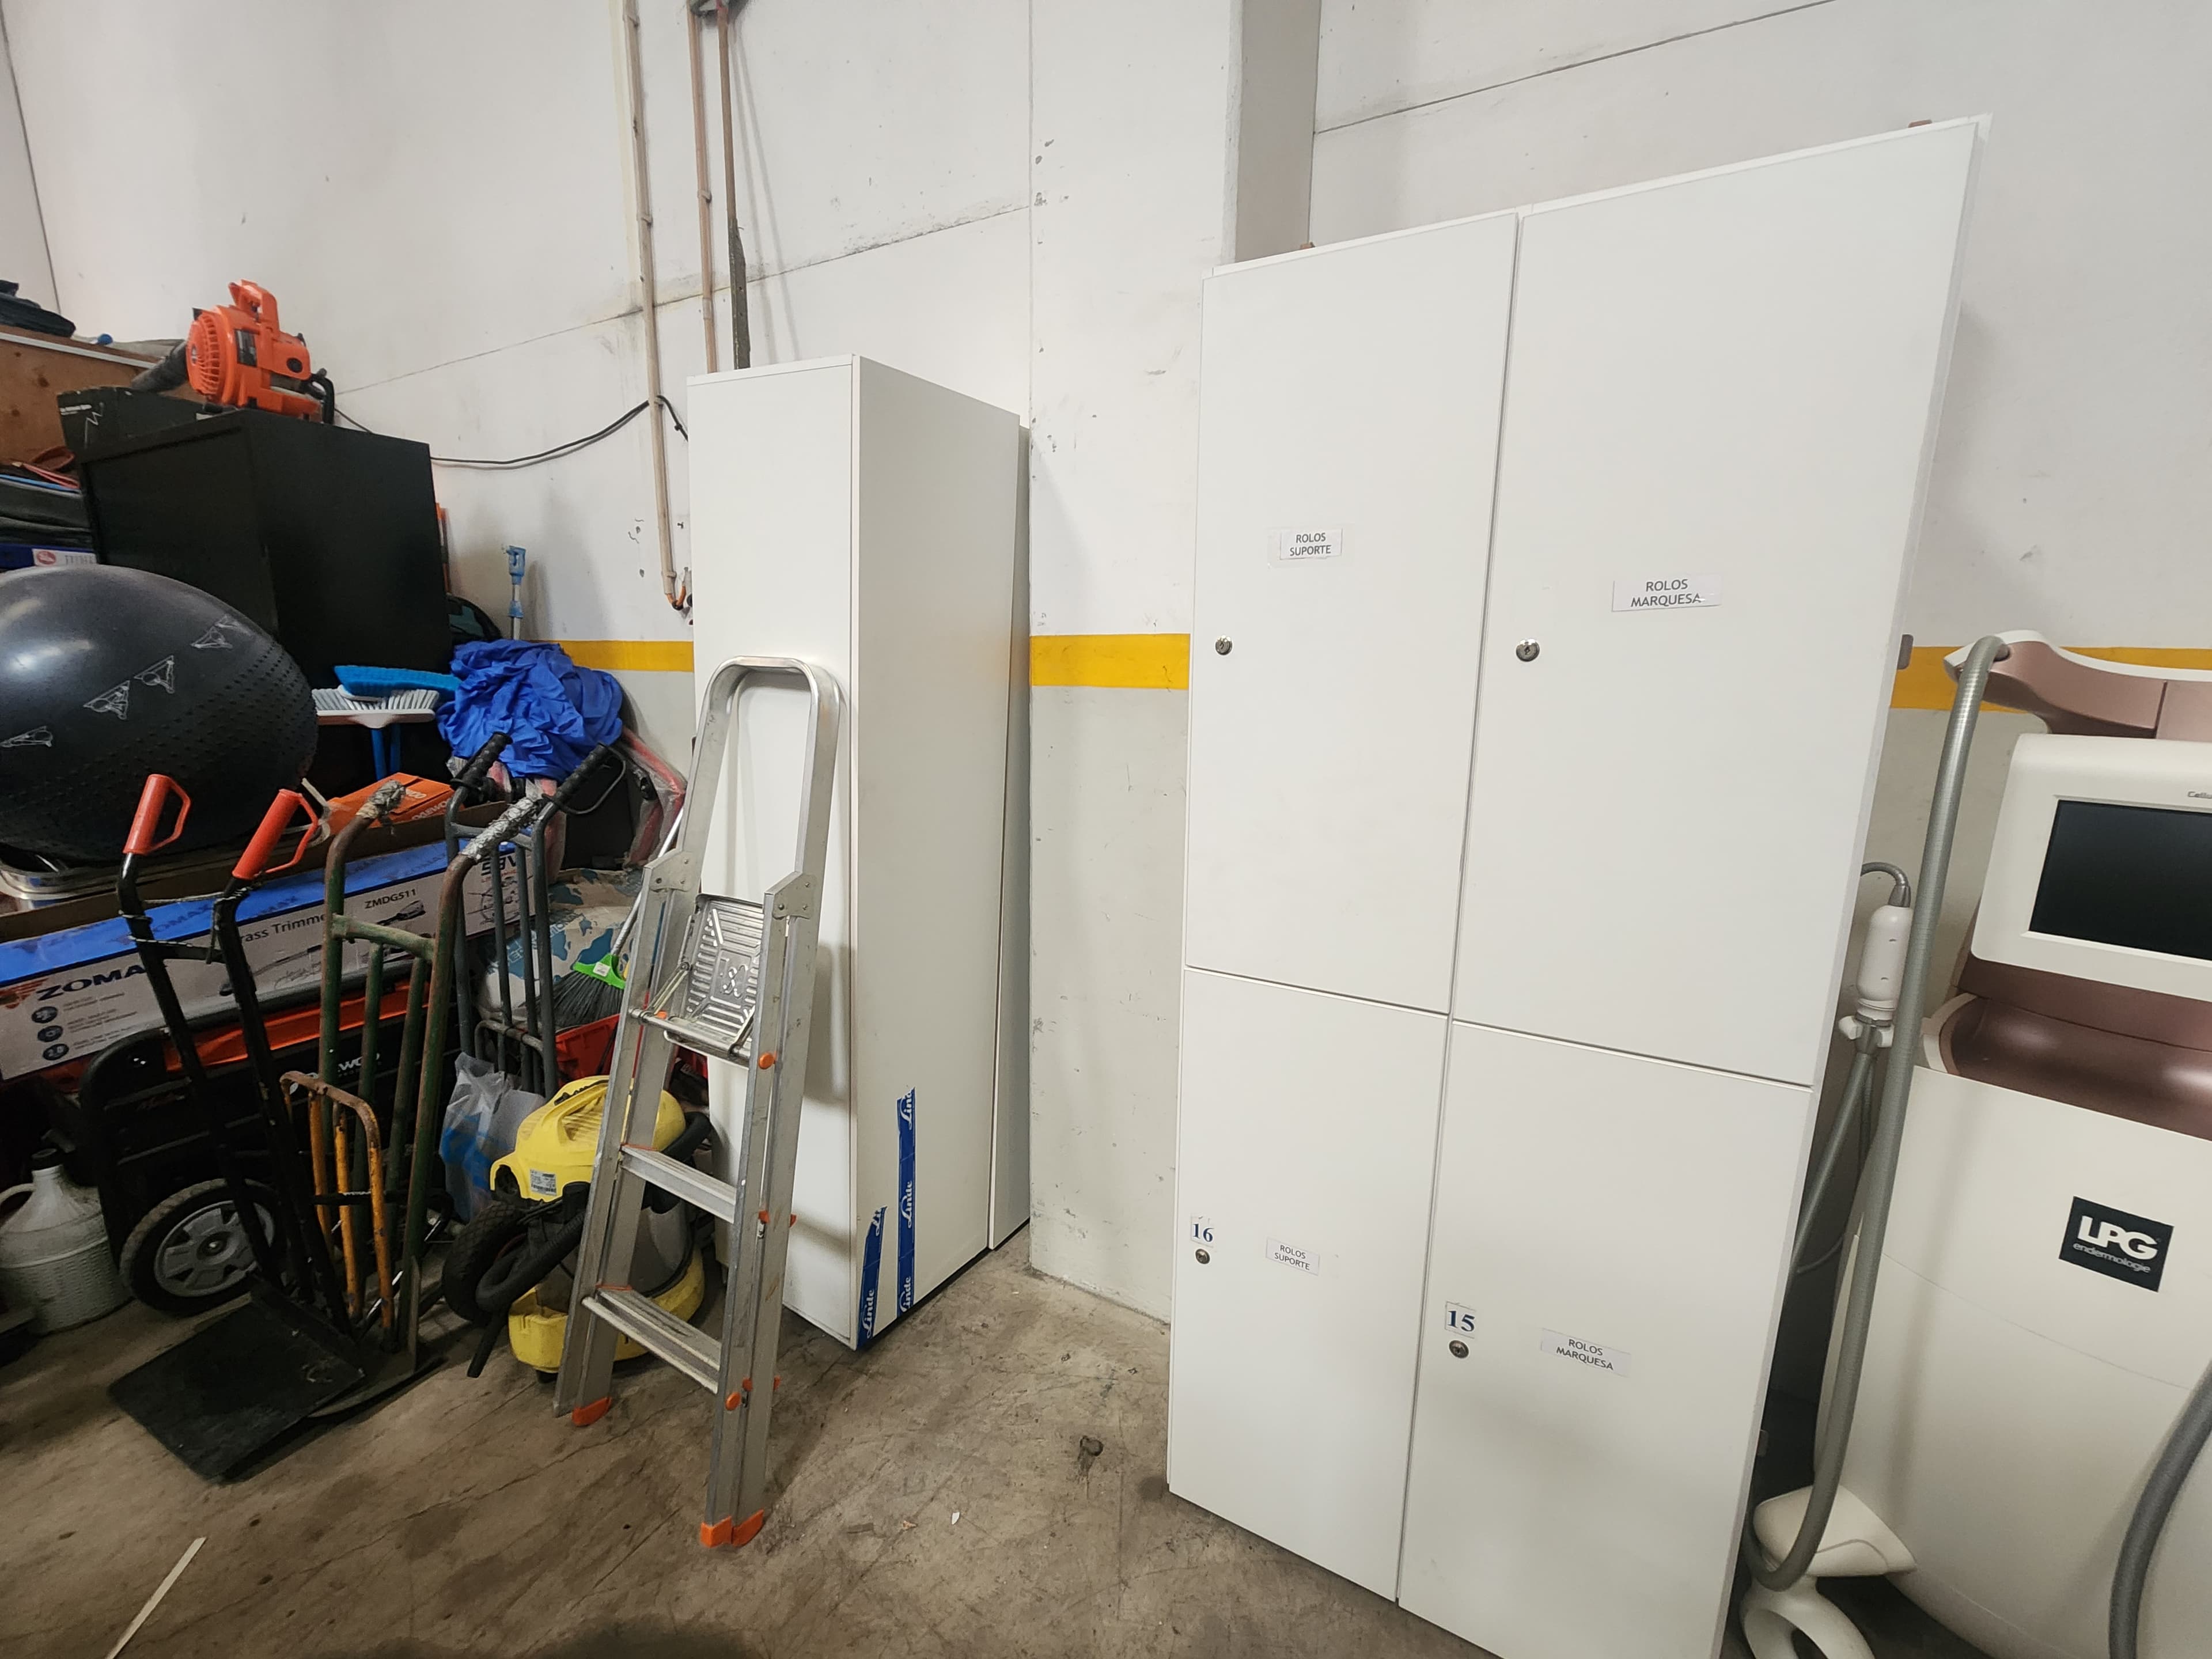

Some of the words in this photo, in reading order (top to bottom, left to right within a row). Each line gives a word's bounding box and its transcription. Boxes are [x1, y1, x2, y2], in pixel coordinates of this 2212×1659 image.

[1296, 532, 1327, 543] ROLOS
[1290, 544, 1332, 556] SUPORTE
[1646, 578, 1688, 592] ROLOS
[1630, 593, 1702, 607] MARQUESA
[411, 798, 450, 820] DAEWO
[239, 929, 269, 943] rass
[272, 912, 327, 934] Trimme
[35, 964, 145, 1001] ZOMA
[901, 1181, 913, 1229] Linde
[1192, 1223, 1215, 1243] 16
[2077, 1215, 2158, 1260] LPG
[1274, 1252, 1310, 1271] SUPORTE
[1279, 1244, 1306, 1259] ROLOS
[862, 1290, 876, 1339] Linde
[1447, 1310, 1475, 1332] 15
[1556, 1346, 1614, 1370] MARQUESA
[1568, 1338, 1604, 1357] ROLOS
